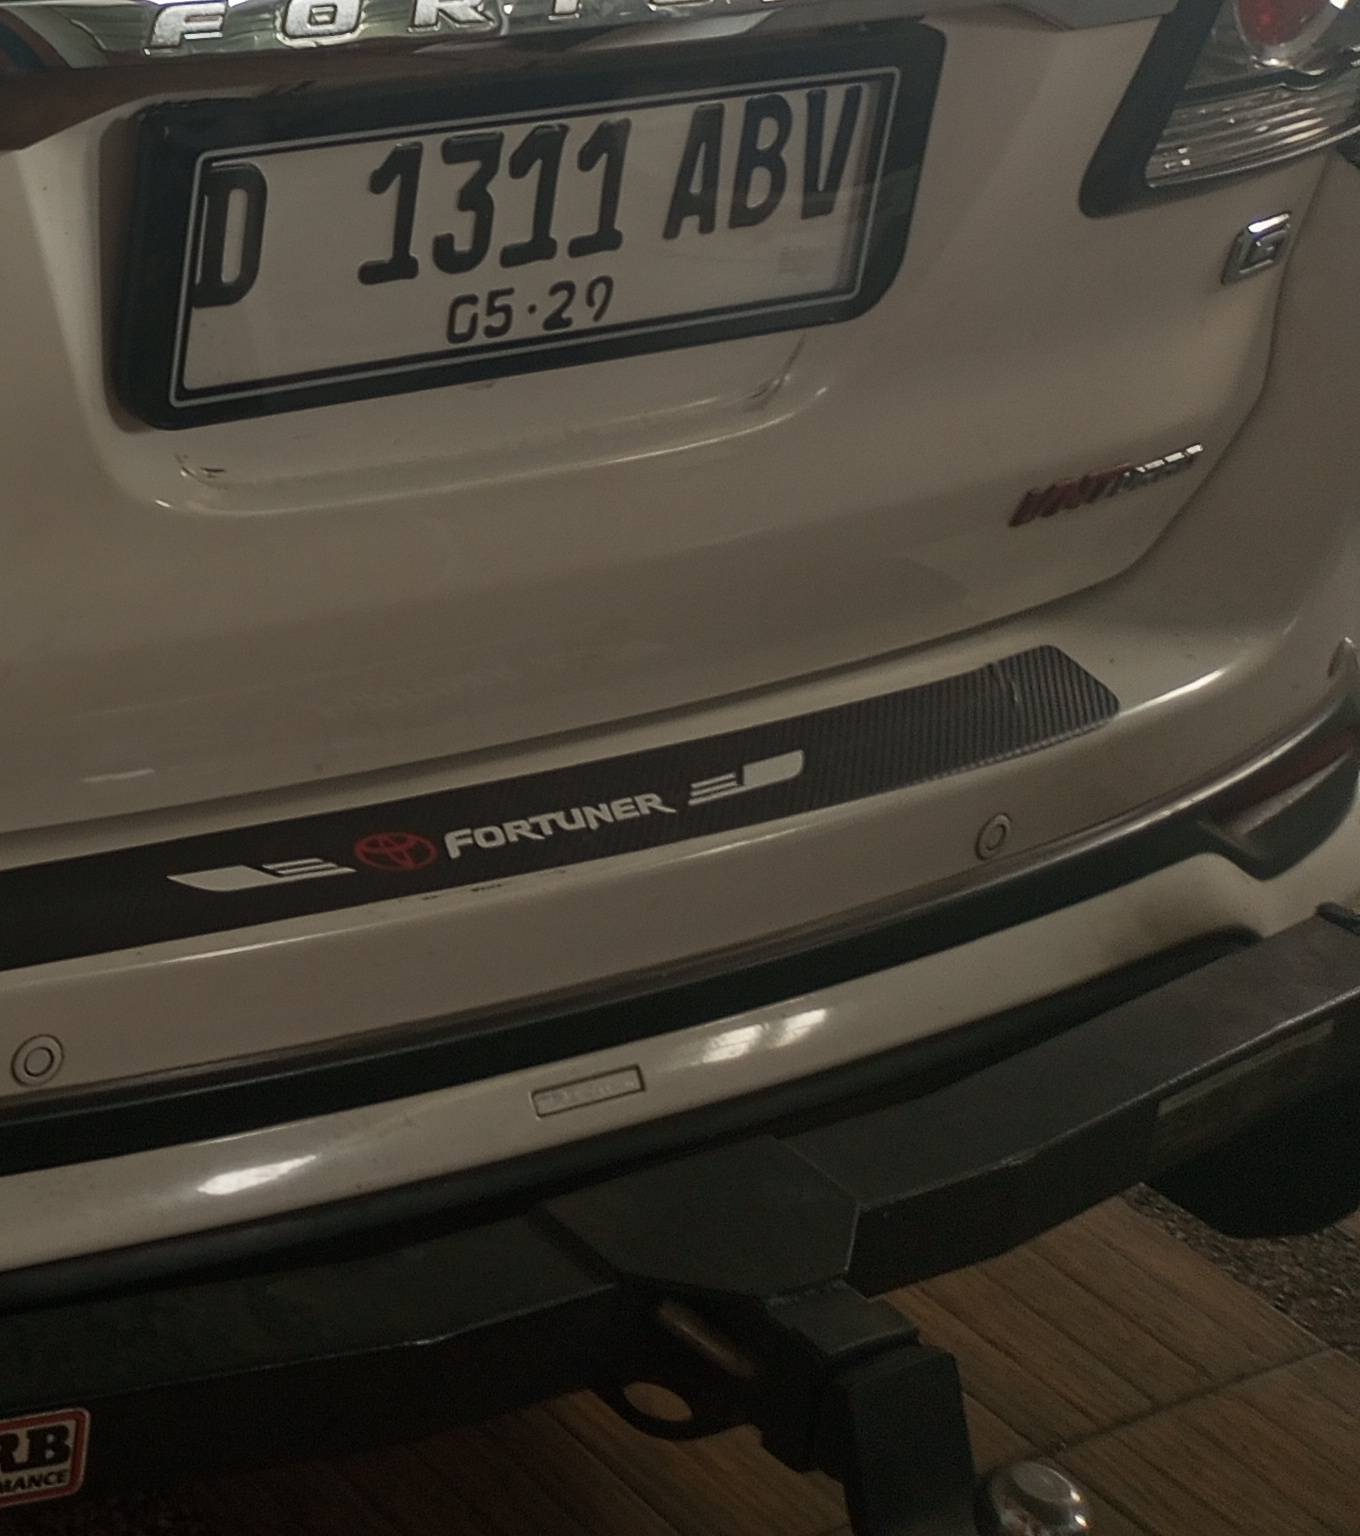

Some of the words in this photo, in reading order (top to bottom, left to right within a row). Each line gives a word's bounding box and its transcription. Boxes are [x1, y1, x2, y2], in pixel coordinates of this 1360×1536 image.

[192, 162, 269, 310] D
[357, 117, 633, 286] 1311
[661, 83, 866, 241] ABV
[443, 794, 677, 859] FORTUNER
